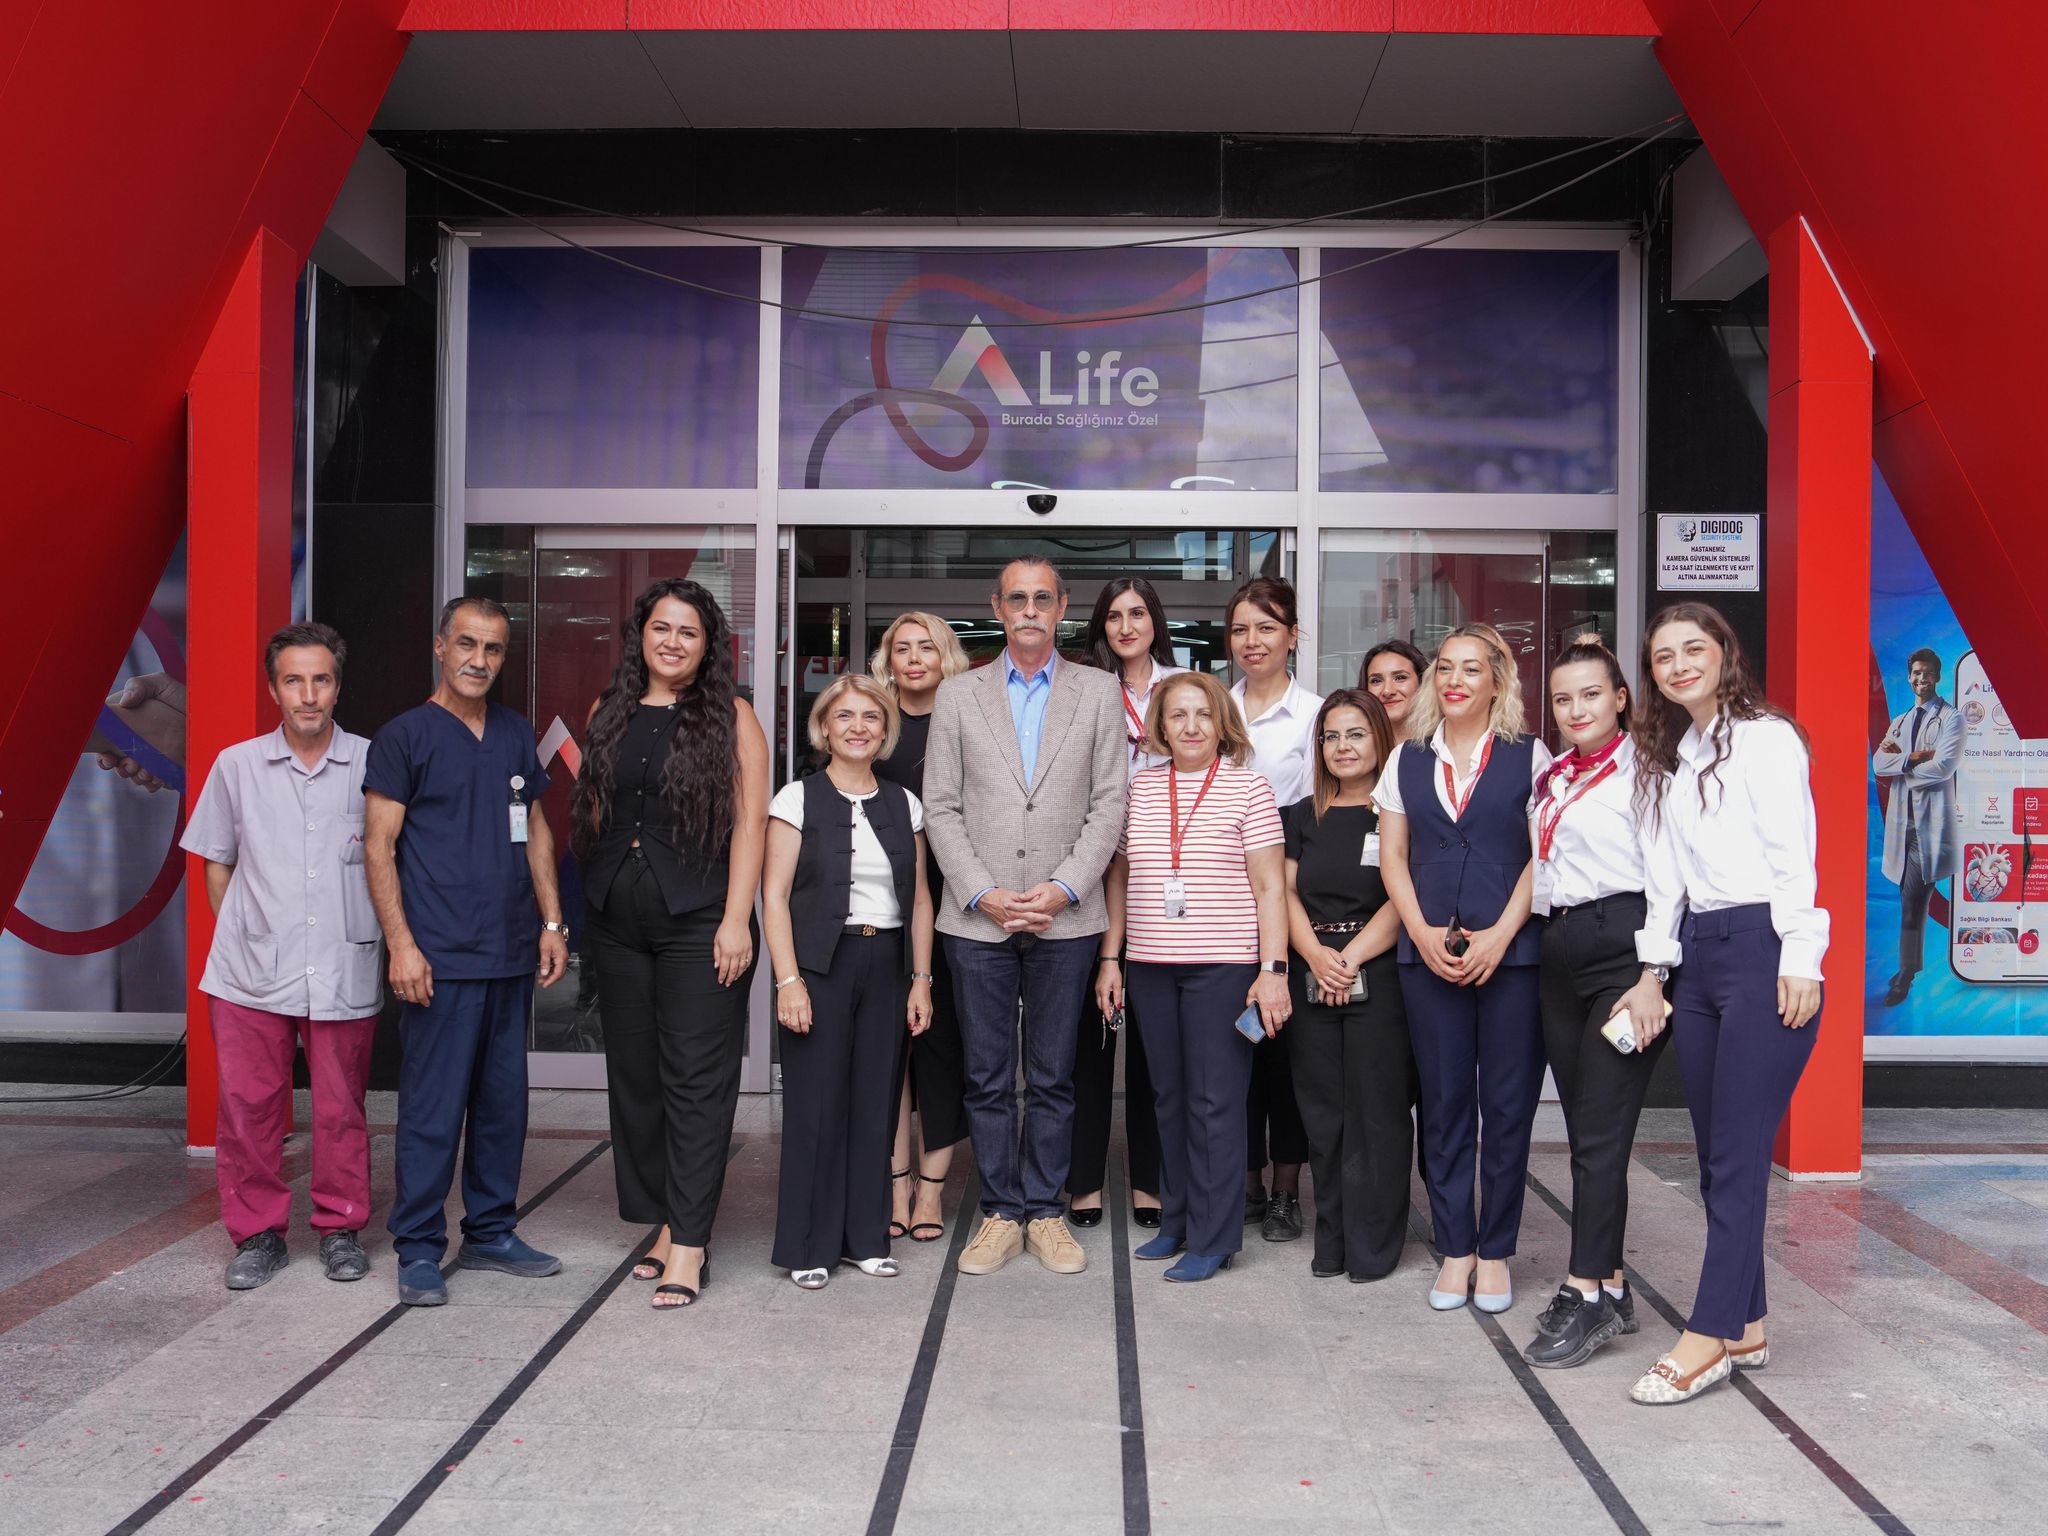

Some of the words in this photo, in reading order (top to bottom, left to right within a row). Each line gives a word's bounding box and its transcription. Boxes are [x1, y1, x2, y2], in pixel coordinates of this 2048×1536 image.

[1001, 412, 1053, 426] Burada
[1056, 412, 1124, 429] Sağlığınız
[1127, 410, 1159, 426] Özel
[1701, 520, 1743, 534] DIGIDOG
[1690, 554, 1718, 562] GÜVENLİK
[1719, 554, 1750, 562] SİSTEMLERİ
[1694, 563, 1728, 571] İZLENMEKTE
[1964, 749, 1980, 757] Size
[1982, 749, 2002, 757] Nasıl
[2003, 749, 2035, 757] Yardımcı
